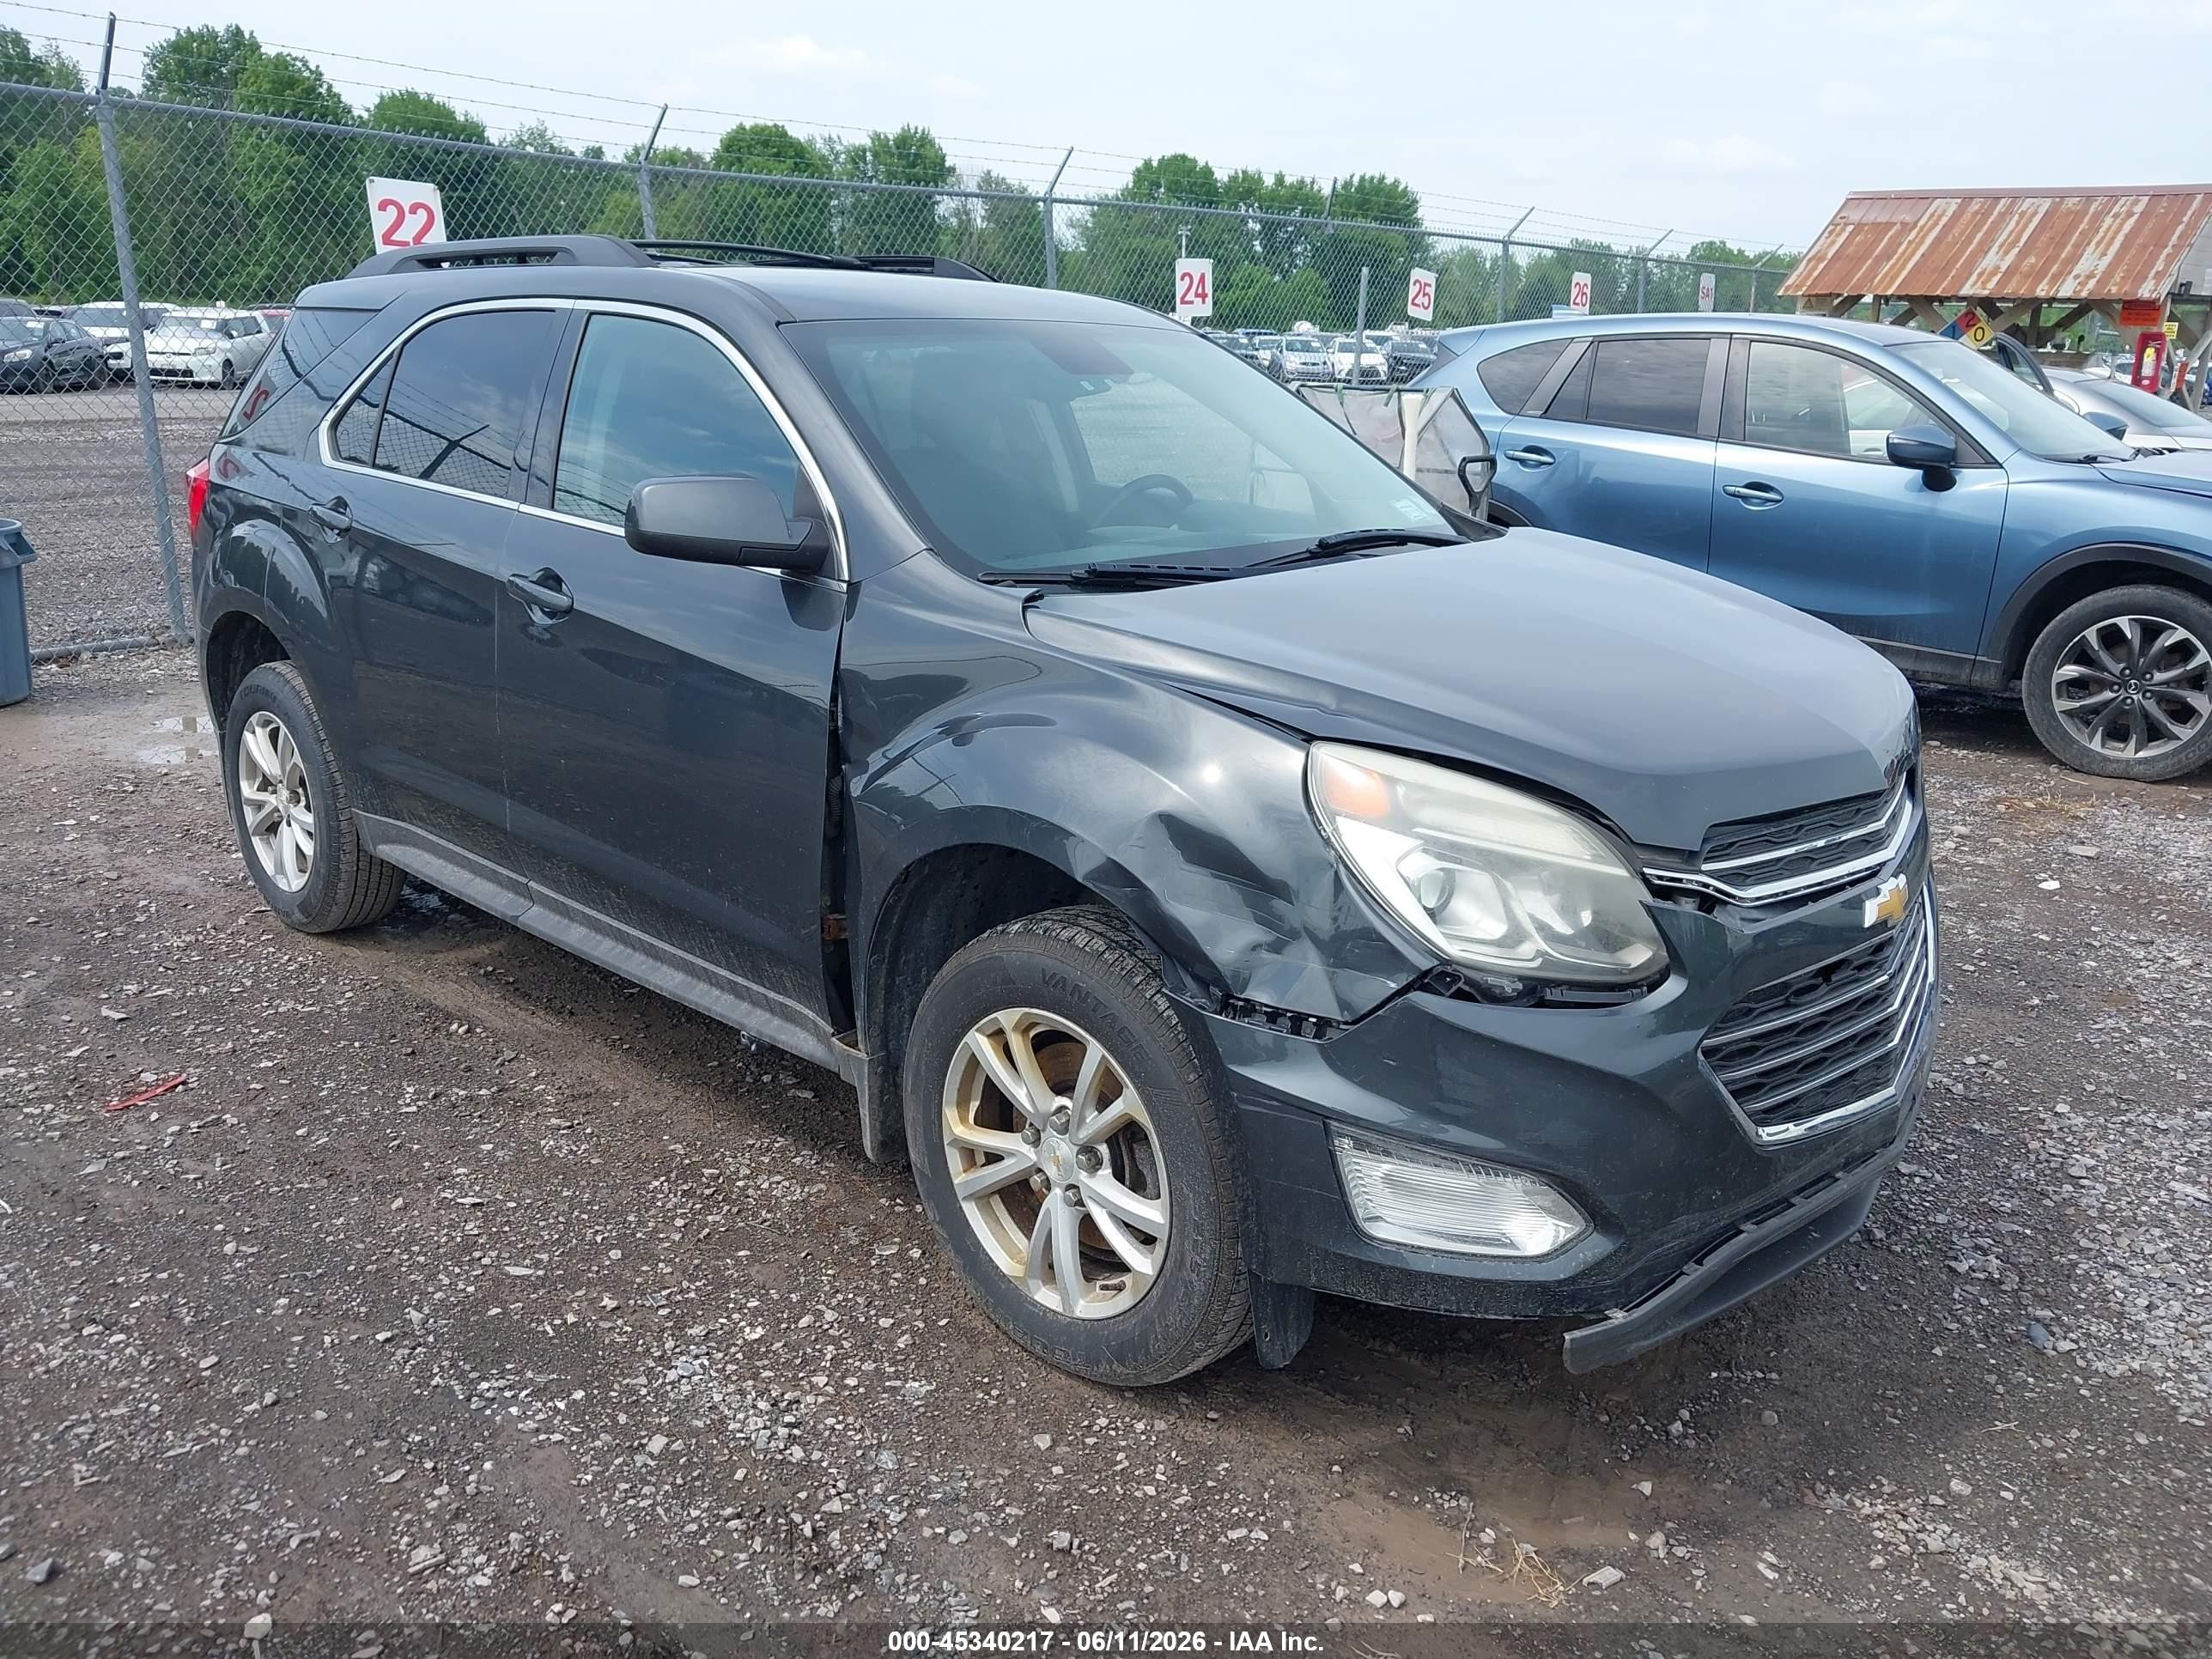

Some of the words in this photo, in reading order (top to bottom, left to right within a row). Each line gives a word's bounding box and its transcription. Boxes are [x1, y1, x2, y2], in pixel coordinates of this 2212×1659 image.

[378, 198, 435, 247] 22
[1180, 271, 1209, 305] 24
[1410, 278, 1432, 311] 25
[1572, 282, 1589, 307] 26
[1965, 312, 1978, 328] 2
[1973, 326, 1985, 343] 0
